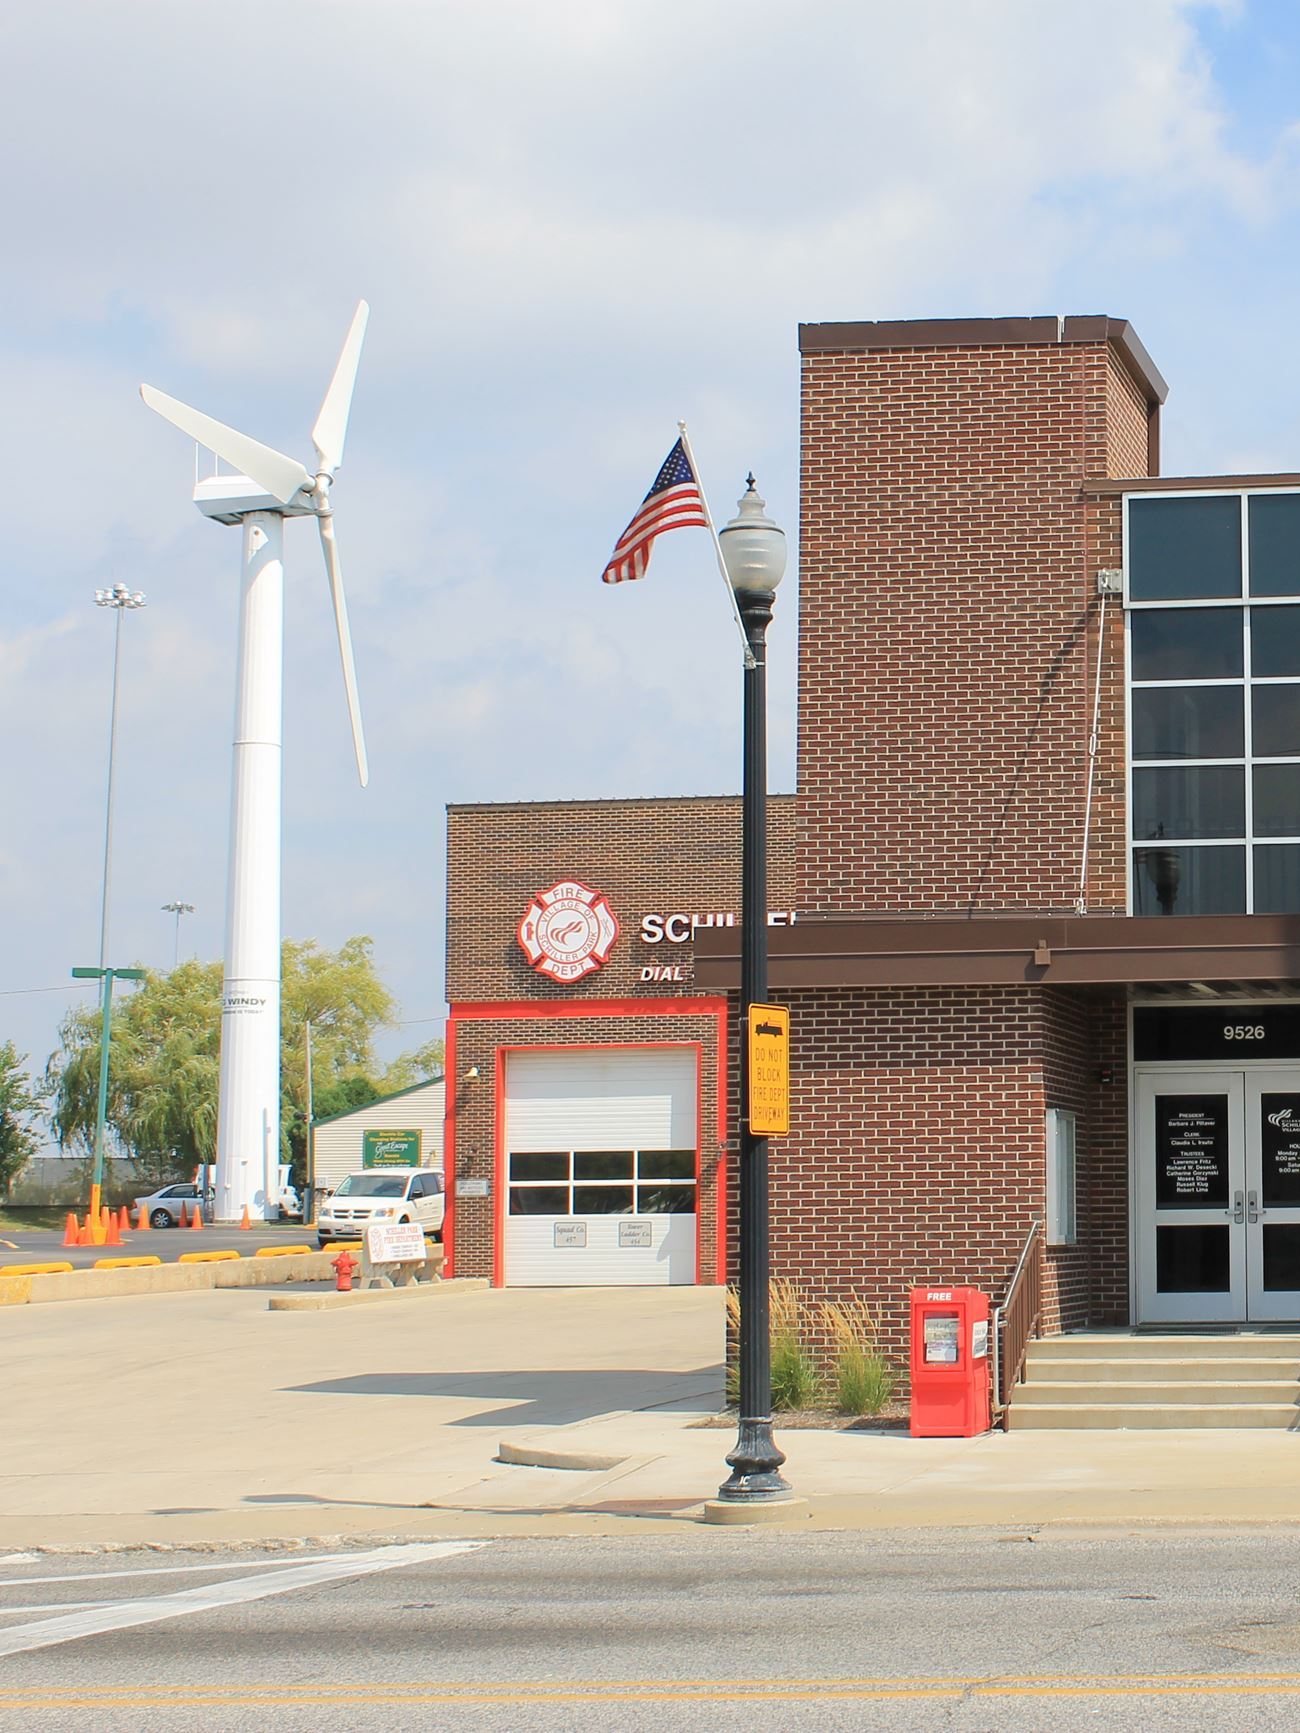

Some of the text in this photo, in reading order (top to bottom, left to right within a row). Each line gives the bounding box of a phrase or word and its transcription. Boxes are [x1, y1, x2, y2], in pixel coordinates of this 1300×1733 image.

[552, 887, 584, 899] FIRE
[541, 900, 594, 923] VILLAGE OF
[539, 931, 598, 962] SCHILLER PARK
[551, 961, 586, 976] DEPT
[640, 966, 684, 981] DIAL
[228, 998, 266, 1006] WINDY
[1224, 1026, 1265, 1040] 9526
[756, 1048, 782, 1062] DO NOT
[757, 1067, 780, 1082] BLOCK
[753, 1086, 785, 1102] FIRE DEPT
[754, 1106, 784, 1120] DRIVEWAY
[927, 1292, 952, 1301] FREE
